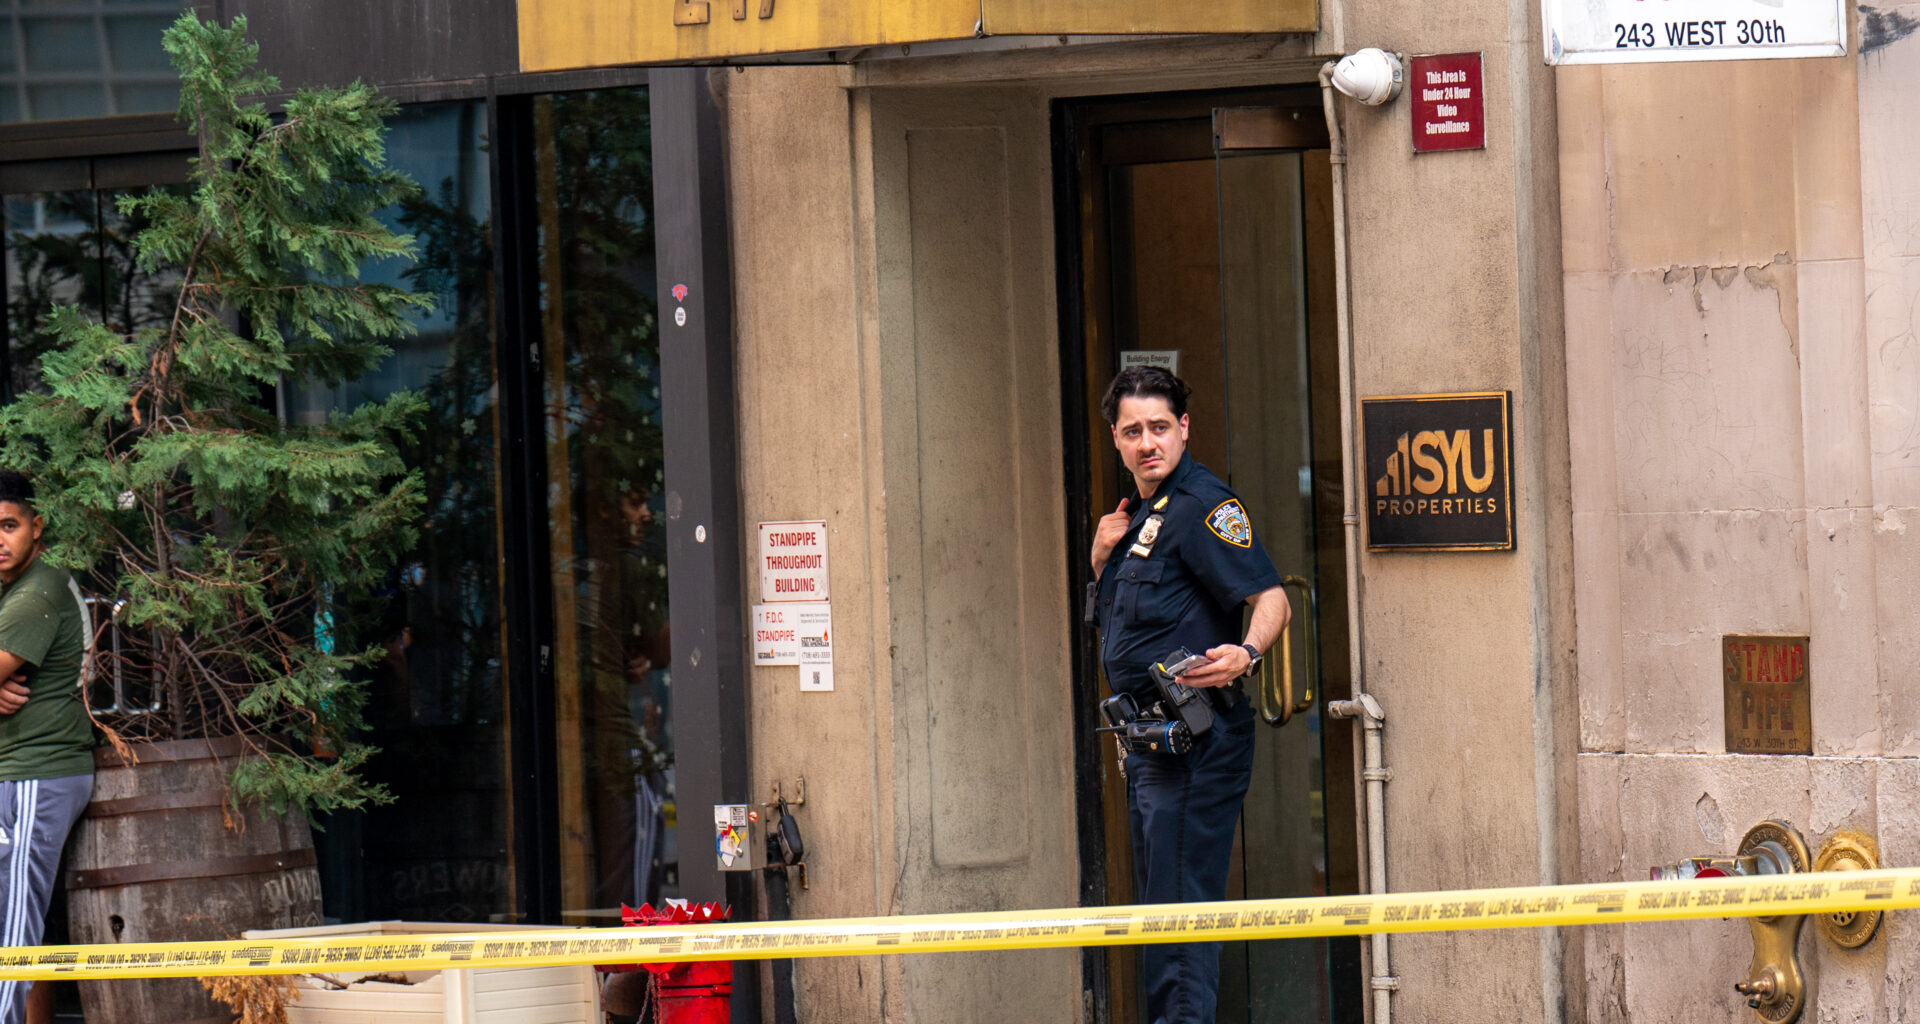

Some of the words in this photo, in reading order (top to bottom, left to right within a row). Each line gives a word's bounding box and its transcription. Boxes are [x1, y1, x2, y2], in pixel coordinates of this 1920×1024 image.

[1615, 22, 1655, 48] 243
[1665, 20, 1727, 47] WEST
[1737, 19, 1786, 44] 30th
[1426, 71, 1441, 84] This
[1442, 70, 1458, 83] Area
[1422, 88, 1444, 101] Under
[1444, 87, 1453, 100] 24
[1454, 87, 1471, 99] Hour
[1437, 104, 1458, 117] Video
[1425, 120, 1470, 135] Surveillance
[1126, 354, 1149, 364] Building
[1150, 354, 1170, 364] Energy
[1376, 498, 1497, 516] PROPERTIES
[769, 531, 817, 547] STANDPIPE
[766, 554, 822, 570] THROUGHOUT
[775, 577, 815, 593] BUILDING
[765, 611, 784, 623] F.D.C.
[756, 629, 795, 642] STANDPIPE
[1726, 643, 1804, 683] STAND
[1742, 690, 1794, 731] PIPE
[364, 944, 383, 962] (8477)
[384, 944, 426, 960] 1-800-577-TIPS
[483, 943, 502, 958] CROSS
[502, 943, 515, 958] NOT
[515, 942, 524, 957] DO
[529, 941, 549, 956] SCENE
[550, 940, 567, 956] CRIME
[589, 938, 633, 953] 1-800-577-TIPS
[281, 949, 300, 963] CROSS
